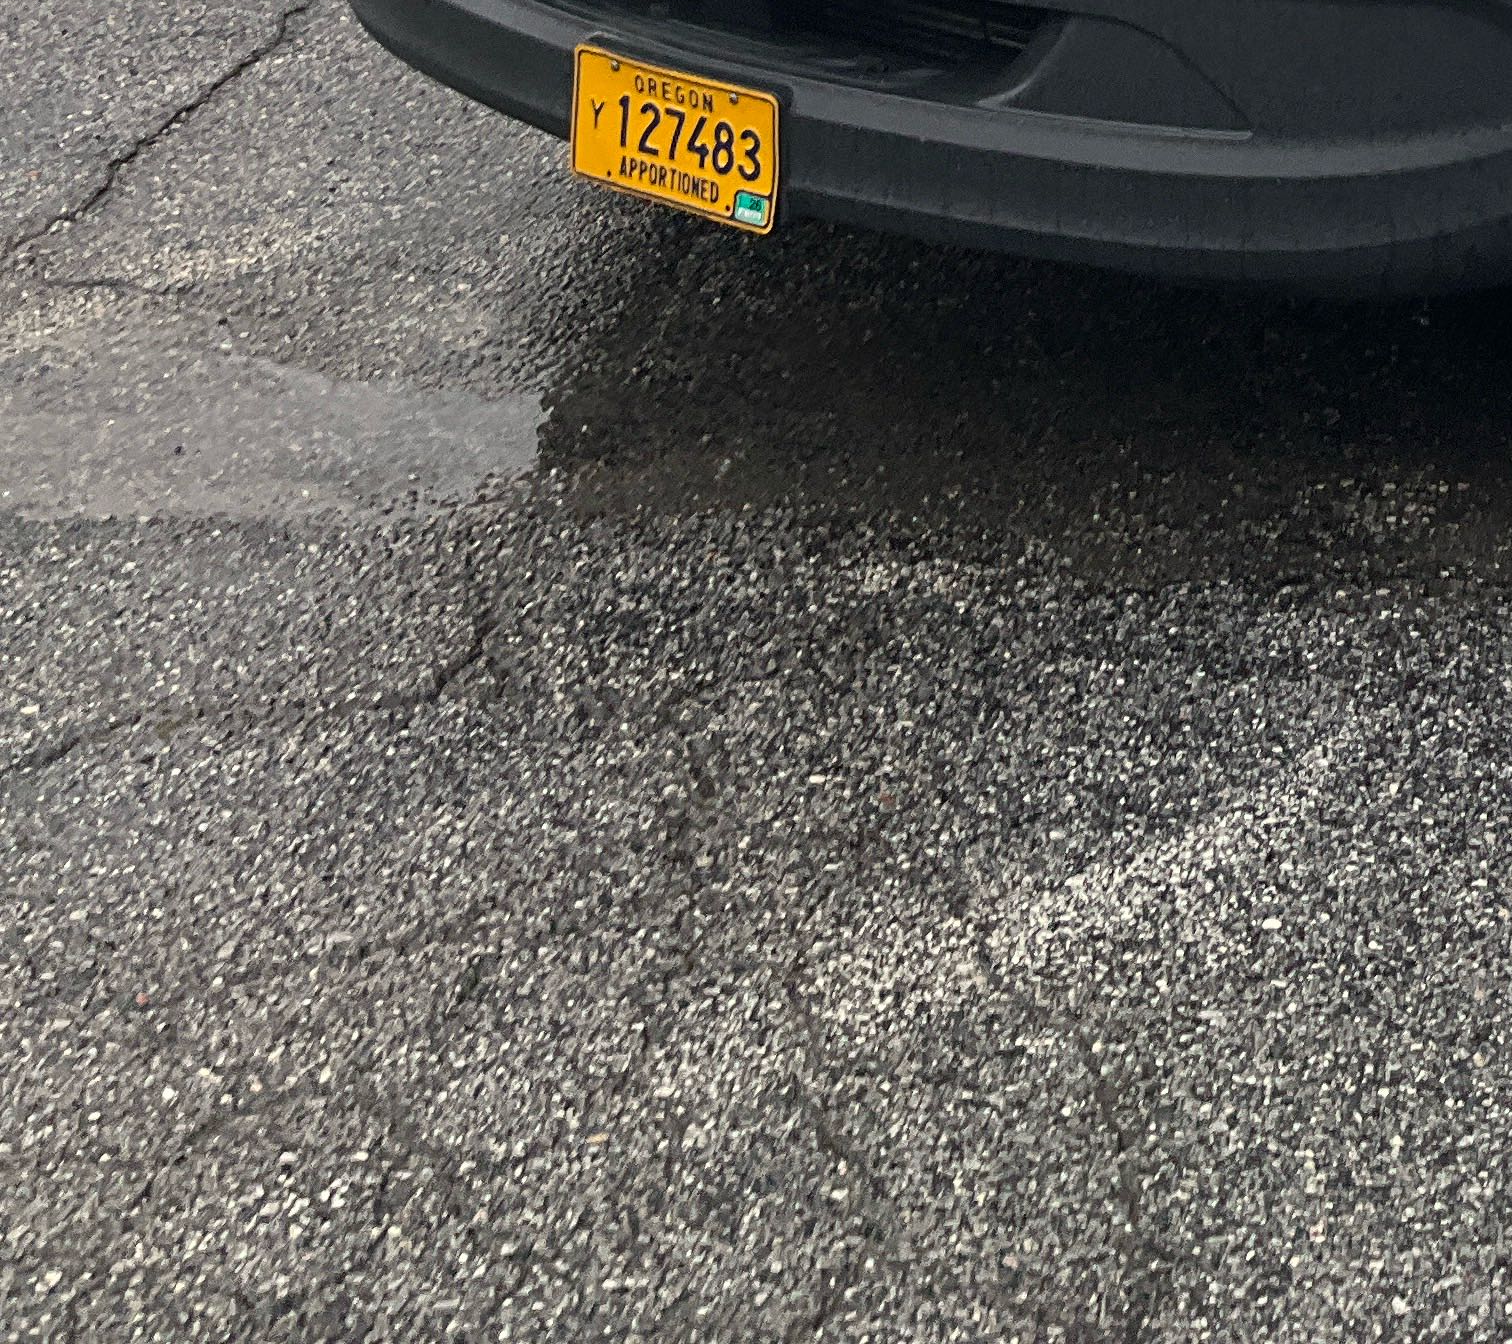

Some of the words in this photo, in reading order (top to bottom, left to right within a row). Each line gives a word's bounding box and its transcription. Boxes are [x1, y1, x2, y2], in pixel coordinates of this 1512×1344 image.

[634, 75, 714, 113] OREGON
[591, 98, 605, 129] Y
[618, 95, 762, 182] 127483
[619, 156, 720, 204] APPORTIONED
